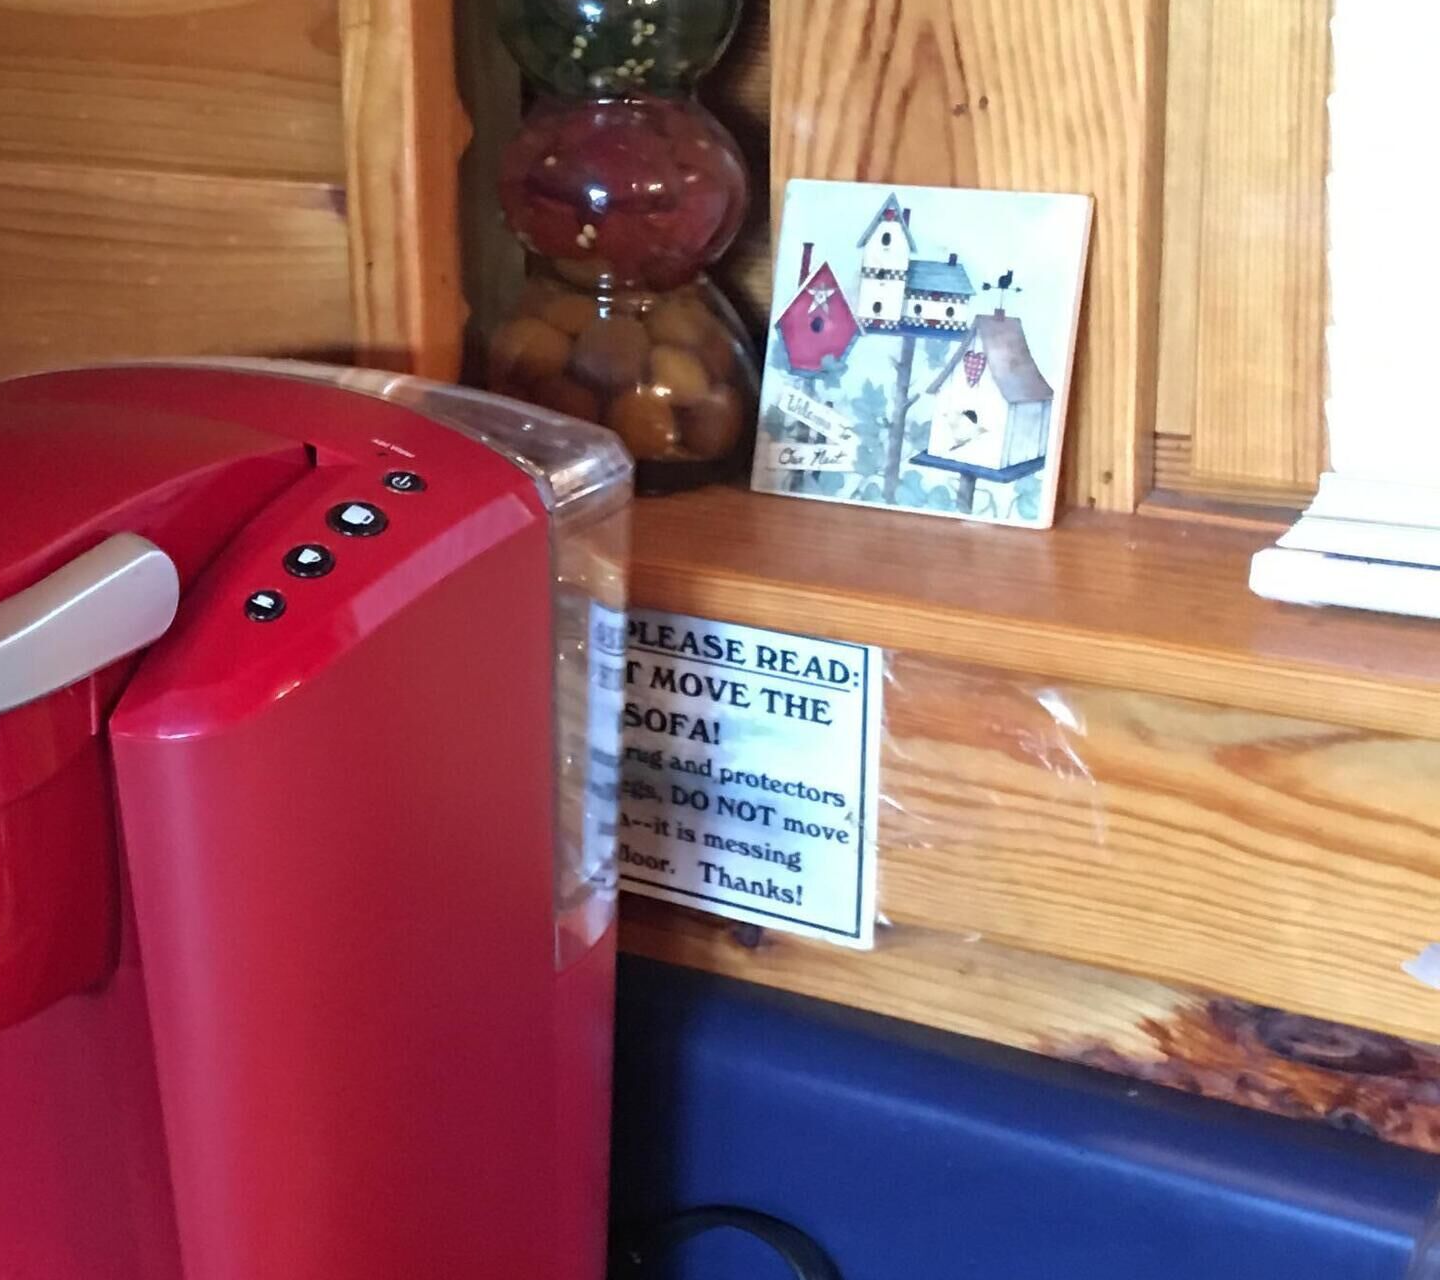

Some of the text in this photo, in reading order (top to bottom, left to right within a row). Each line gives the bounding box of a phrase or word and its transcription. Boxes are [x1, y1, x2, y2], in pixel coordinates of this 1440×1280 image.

[755, 643, 860, 688] READ:
[649, 665, 751, 710] MOVE
[760, 686, 834, 726] THE
[621, 702, 721, 745] SOFA!
[669, 754, 713, 779] and
[719, 765, 847, 808] protectors
[670, 784, 709, 811] DO
[716, 795, 776, 827] NOT
[782, 814, 850, 845] move
[676, 818, 696, 843] is
[703, 832, 803, 873] messing
[697, 860, 804, 907] Thanks!
